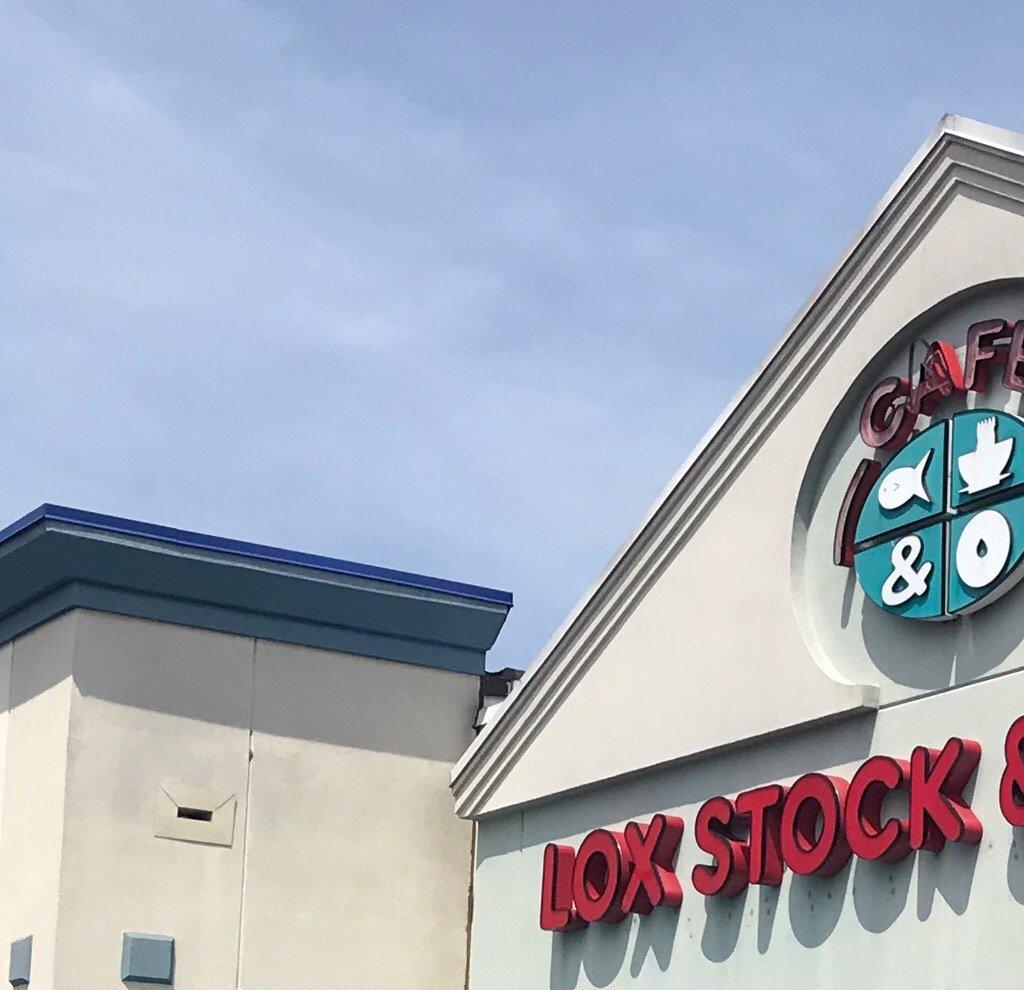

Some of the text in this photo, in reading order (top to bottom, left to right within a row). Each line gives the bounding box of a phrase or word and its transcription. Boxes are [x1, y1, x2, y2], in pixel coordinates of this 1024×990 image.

[881, 534, 933, 606] &
[540, 813, 685, 932] LOX
[691, 736, 983, 898] STOCK
